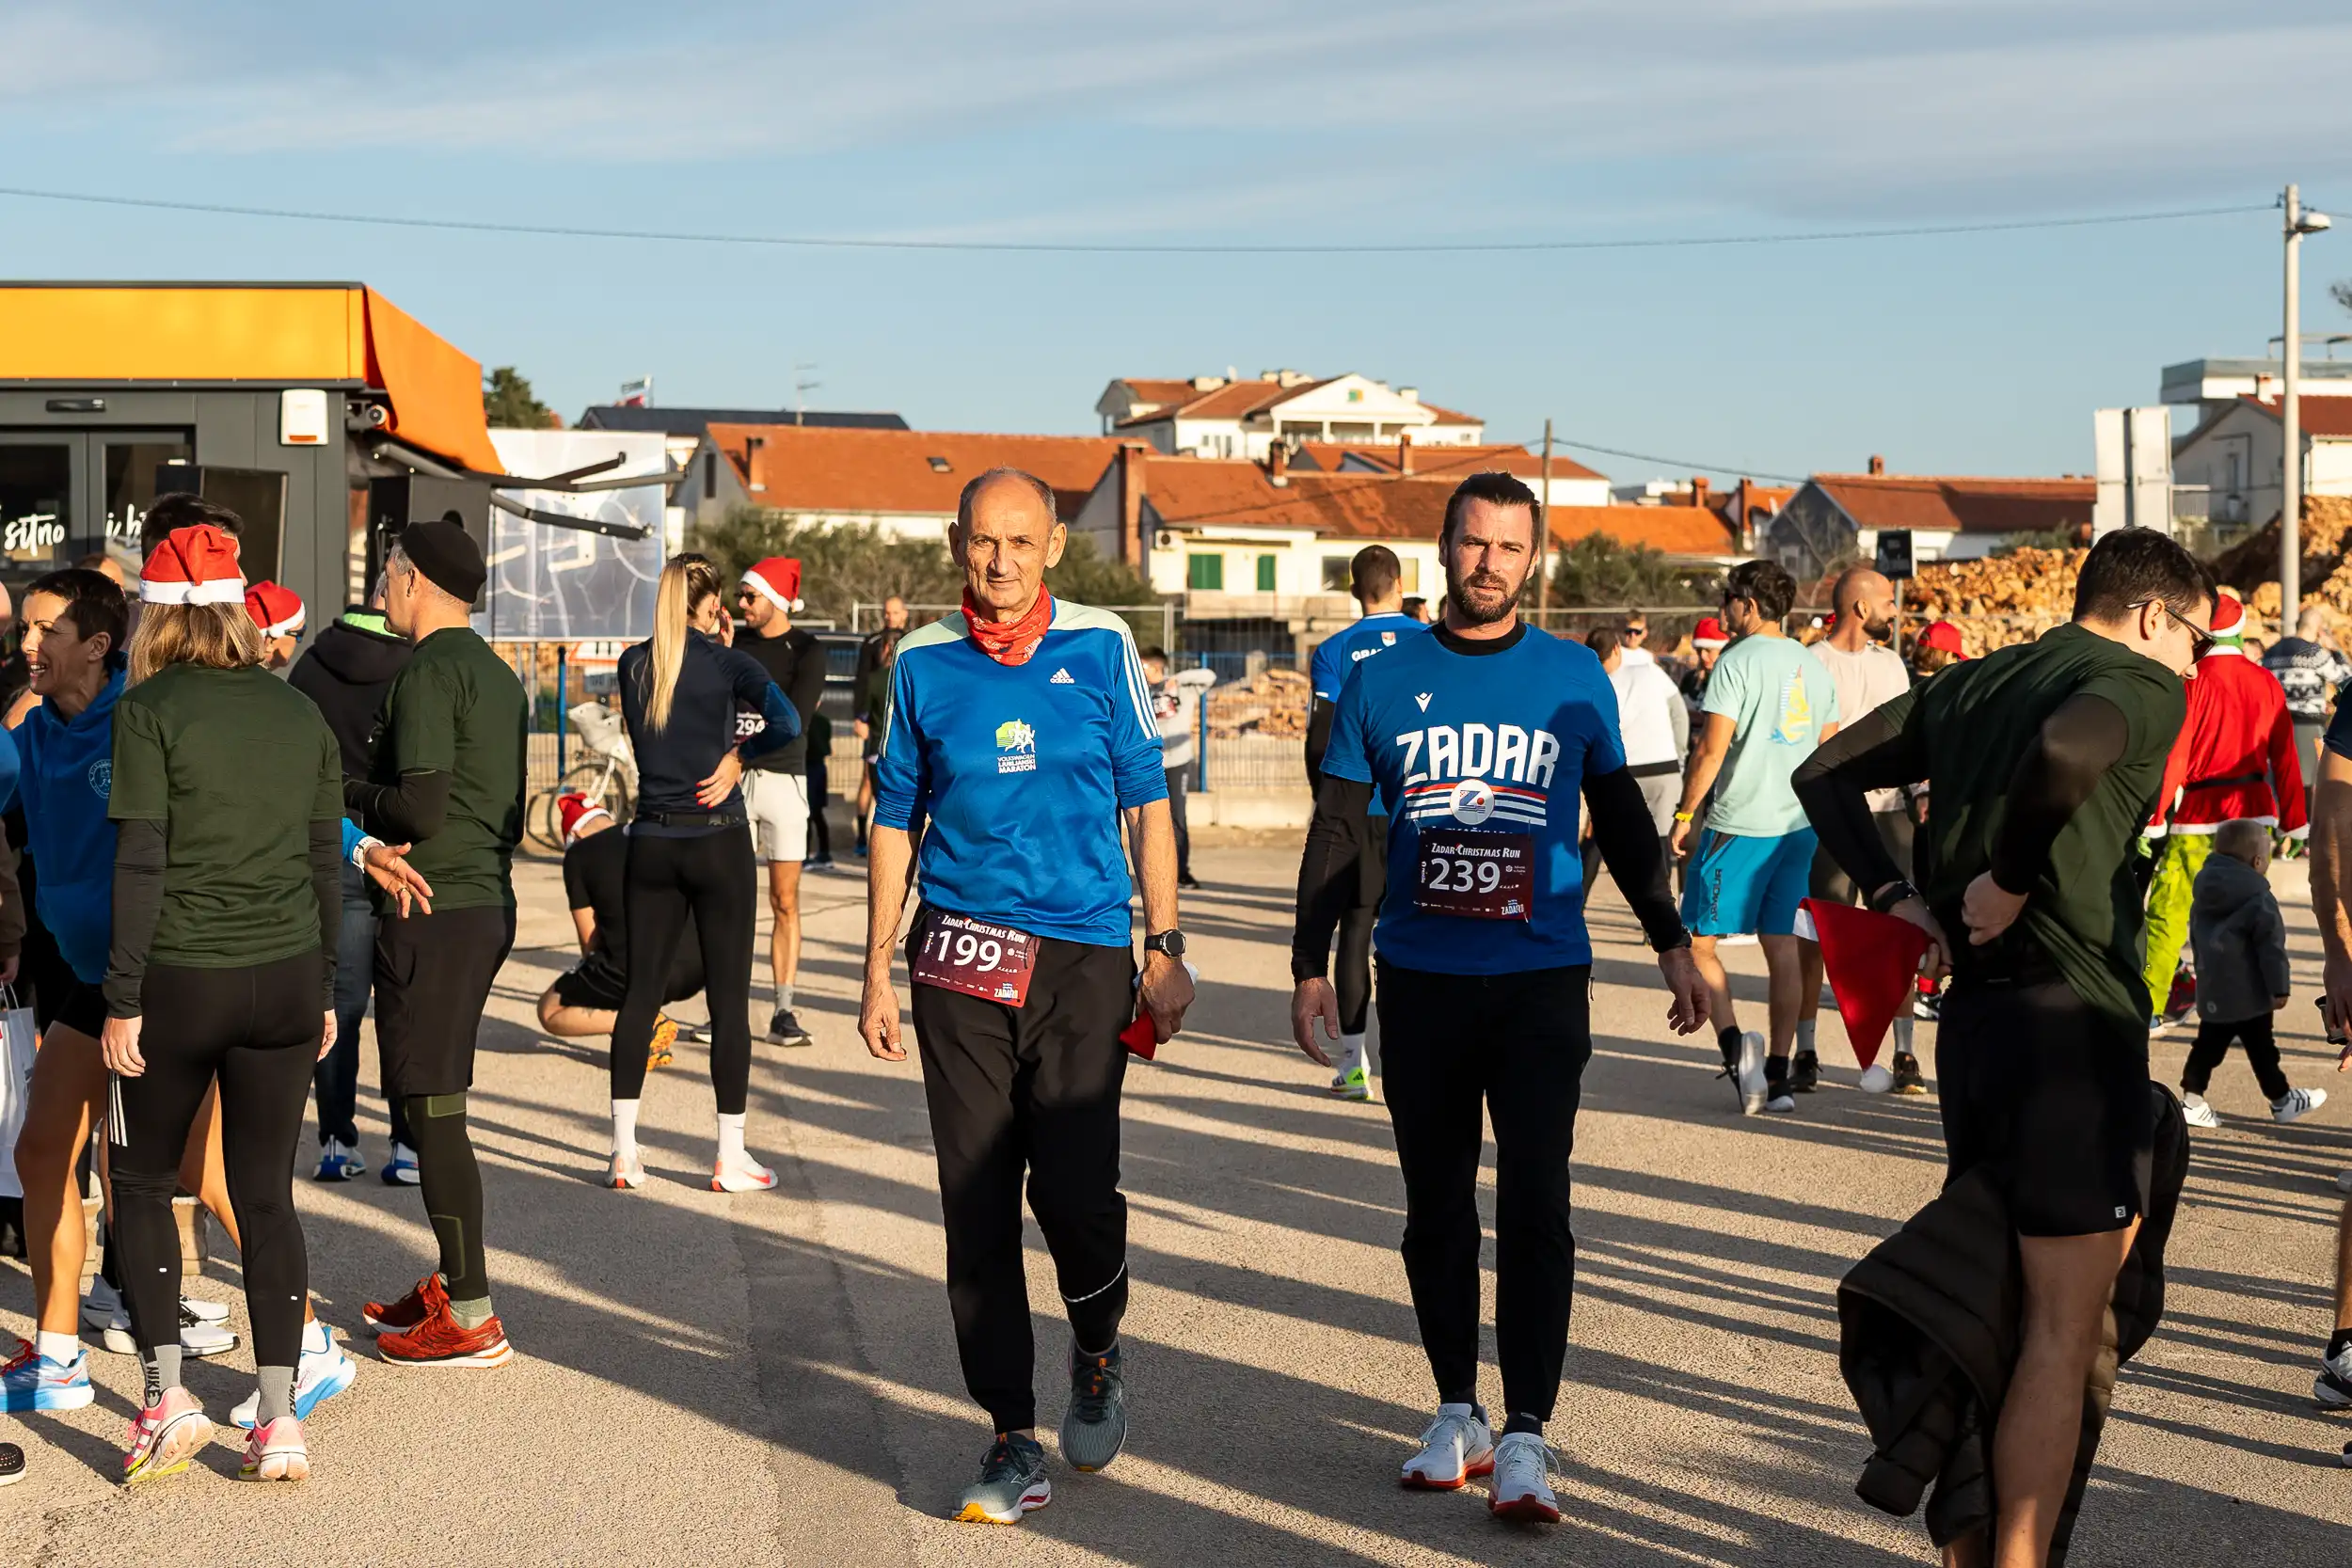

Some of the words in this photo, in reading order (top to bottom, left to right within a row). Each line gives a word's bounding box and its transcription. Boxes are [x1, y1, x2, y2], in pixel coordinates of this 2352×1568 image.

[4, 514, 65, 557] sitno
[999, 764, 1037, 773] MARATON
[1396, 722, 1561, 788] ZADAR
[1431, 843, 1455, 854] ZADAR
[1455, 844, 1502, 858] CHRISTMAS
[1502, 847, 1520, 858] RUN
[1429, 858, 1501, 893] 239
[1710, 869, 1722, 922] ARMOUR
[942, 915, 963, 928] ZADAR
[963, 918, 1008, 938] CHRISTMAS
[1007, 929, 1026, 943] RUN
[937, 930, 1002, 972] 199
[147, 1366, 161, 1399] NIKE
[289, 1384, 297, 1417] NIKE
